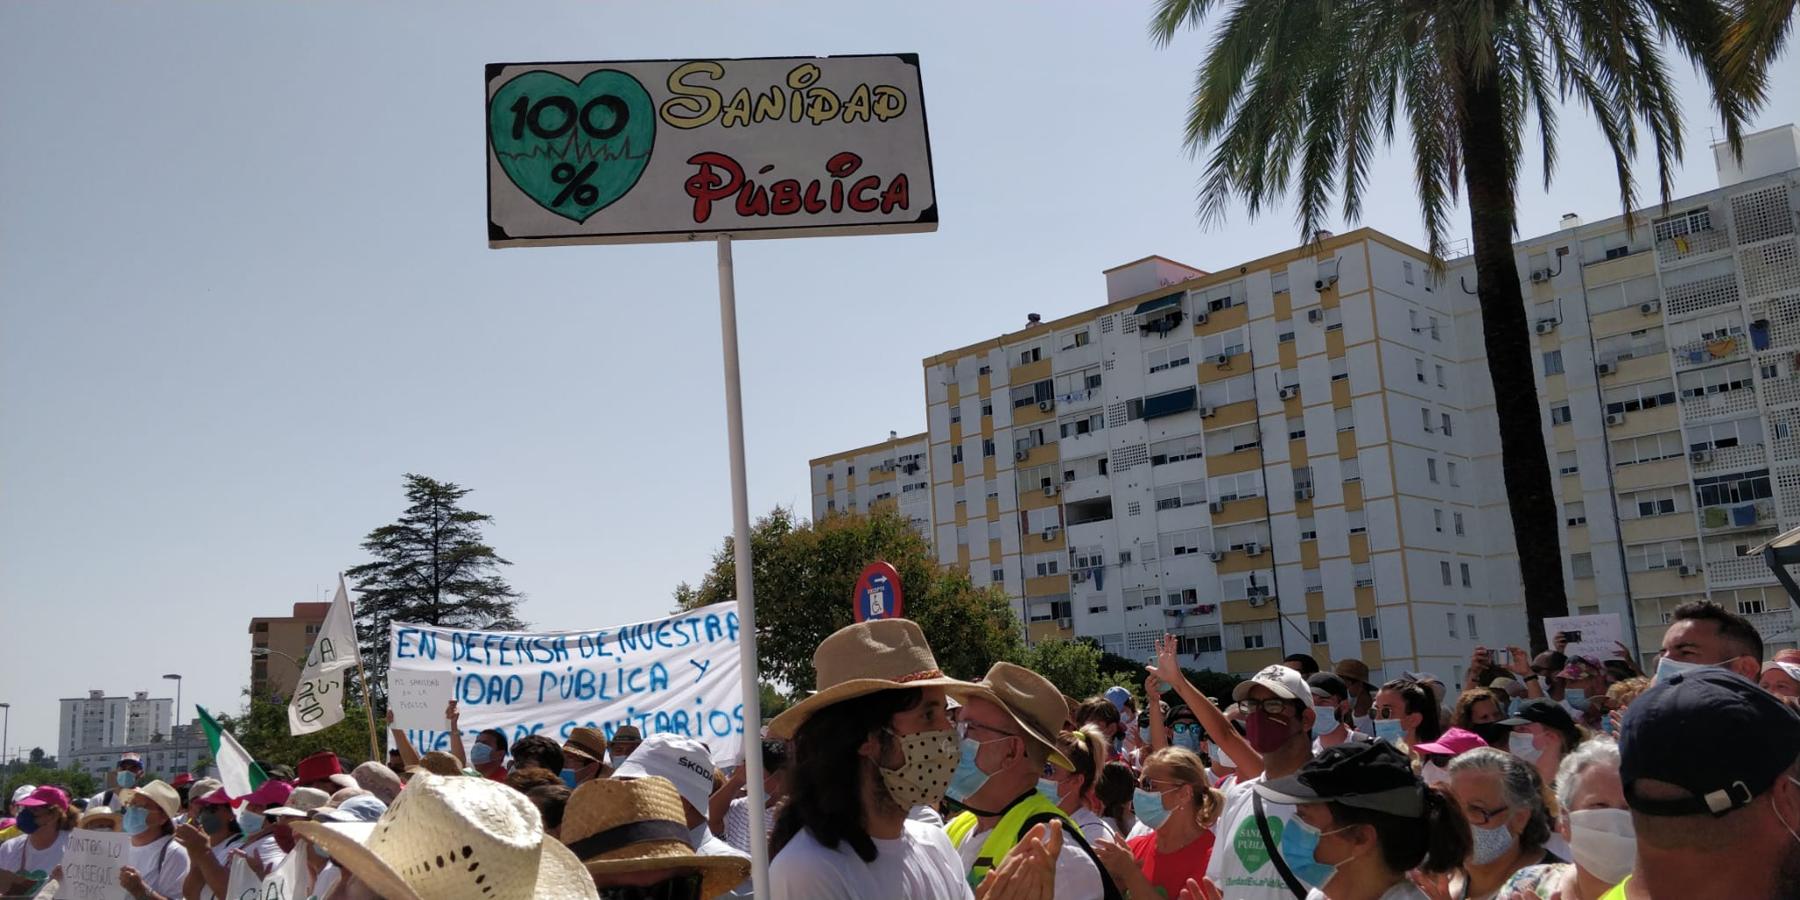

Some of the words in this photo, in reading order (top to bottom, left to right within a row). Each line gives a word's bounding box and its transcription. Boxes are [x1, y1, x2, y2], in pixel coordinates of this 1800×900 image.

[510, 95, 629, 140] 100
[551, 161, 599, 208] %
[397, 629, 437, 660] EN
[452, 632, 569, 666] DEFENSA
[579, 631, 613, 659] DE
[617, 611, 739, 654] NUESTRA
[690, 659, 710, 683] Y
